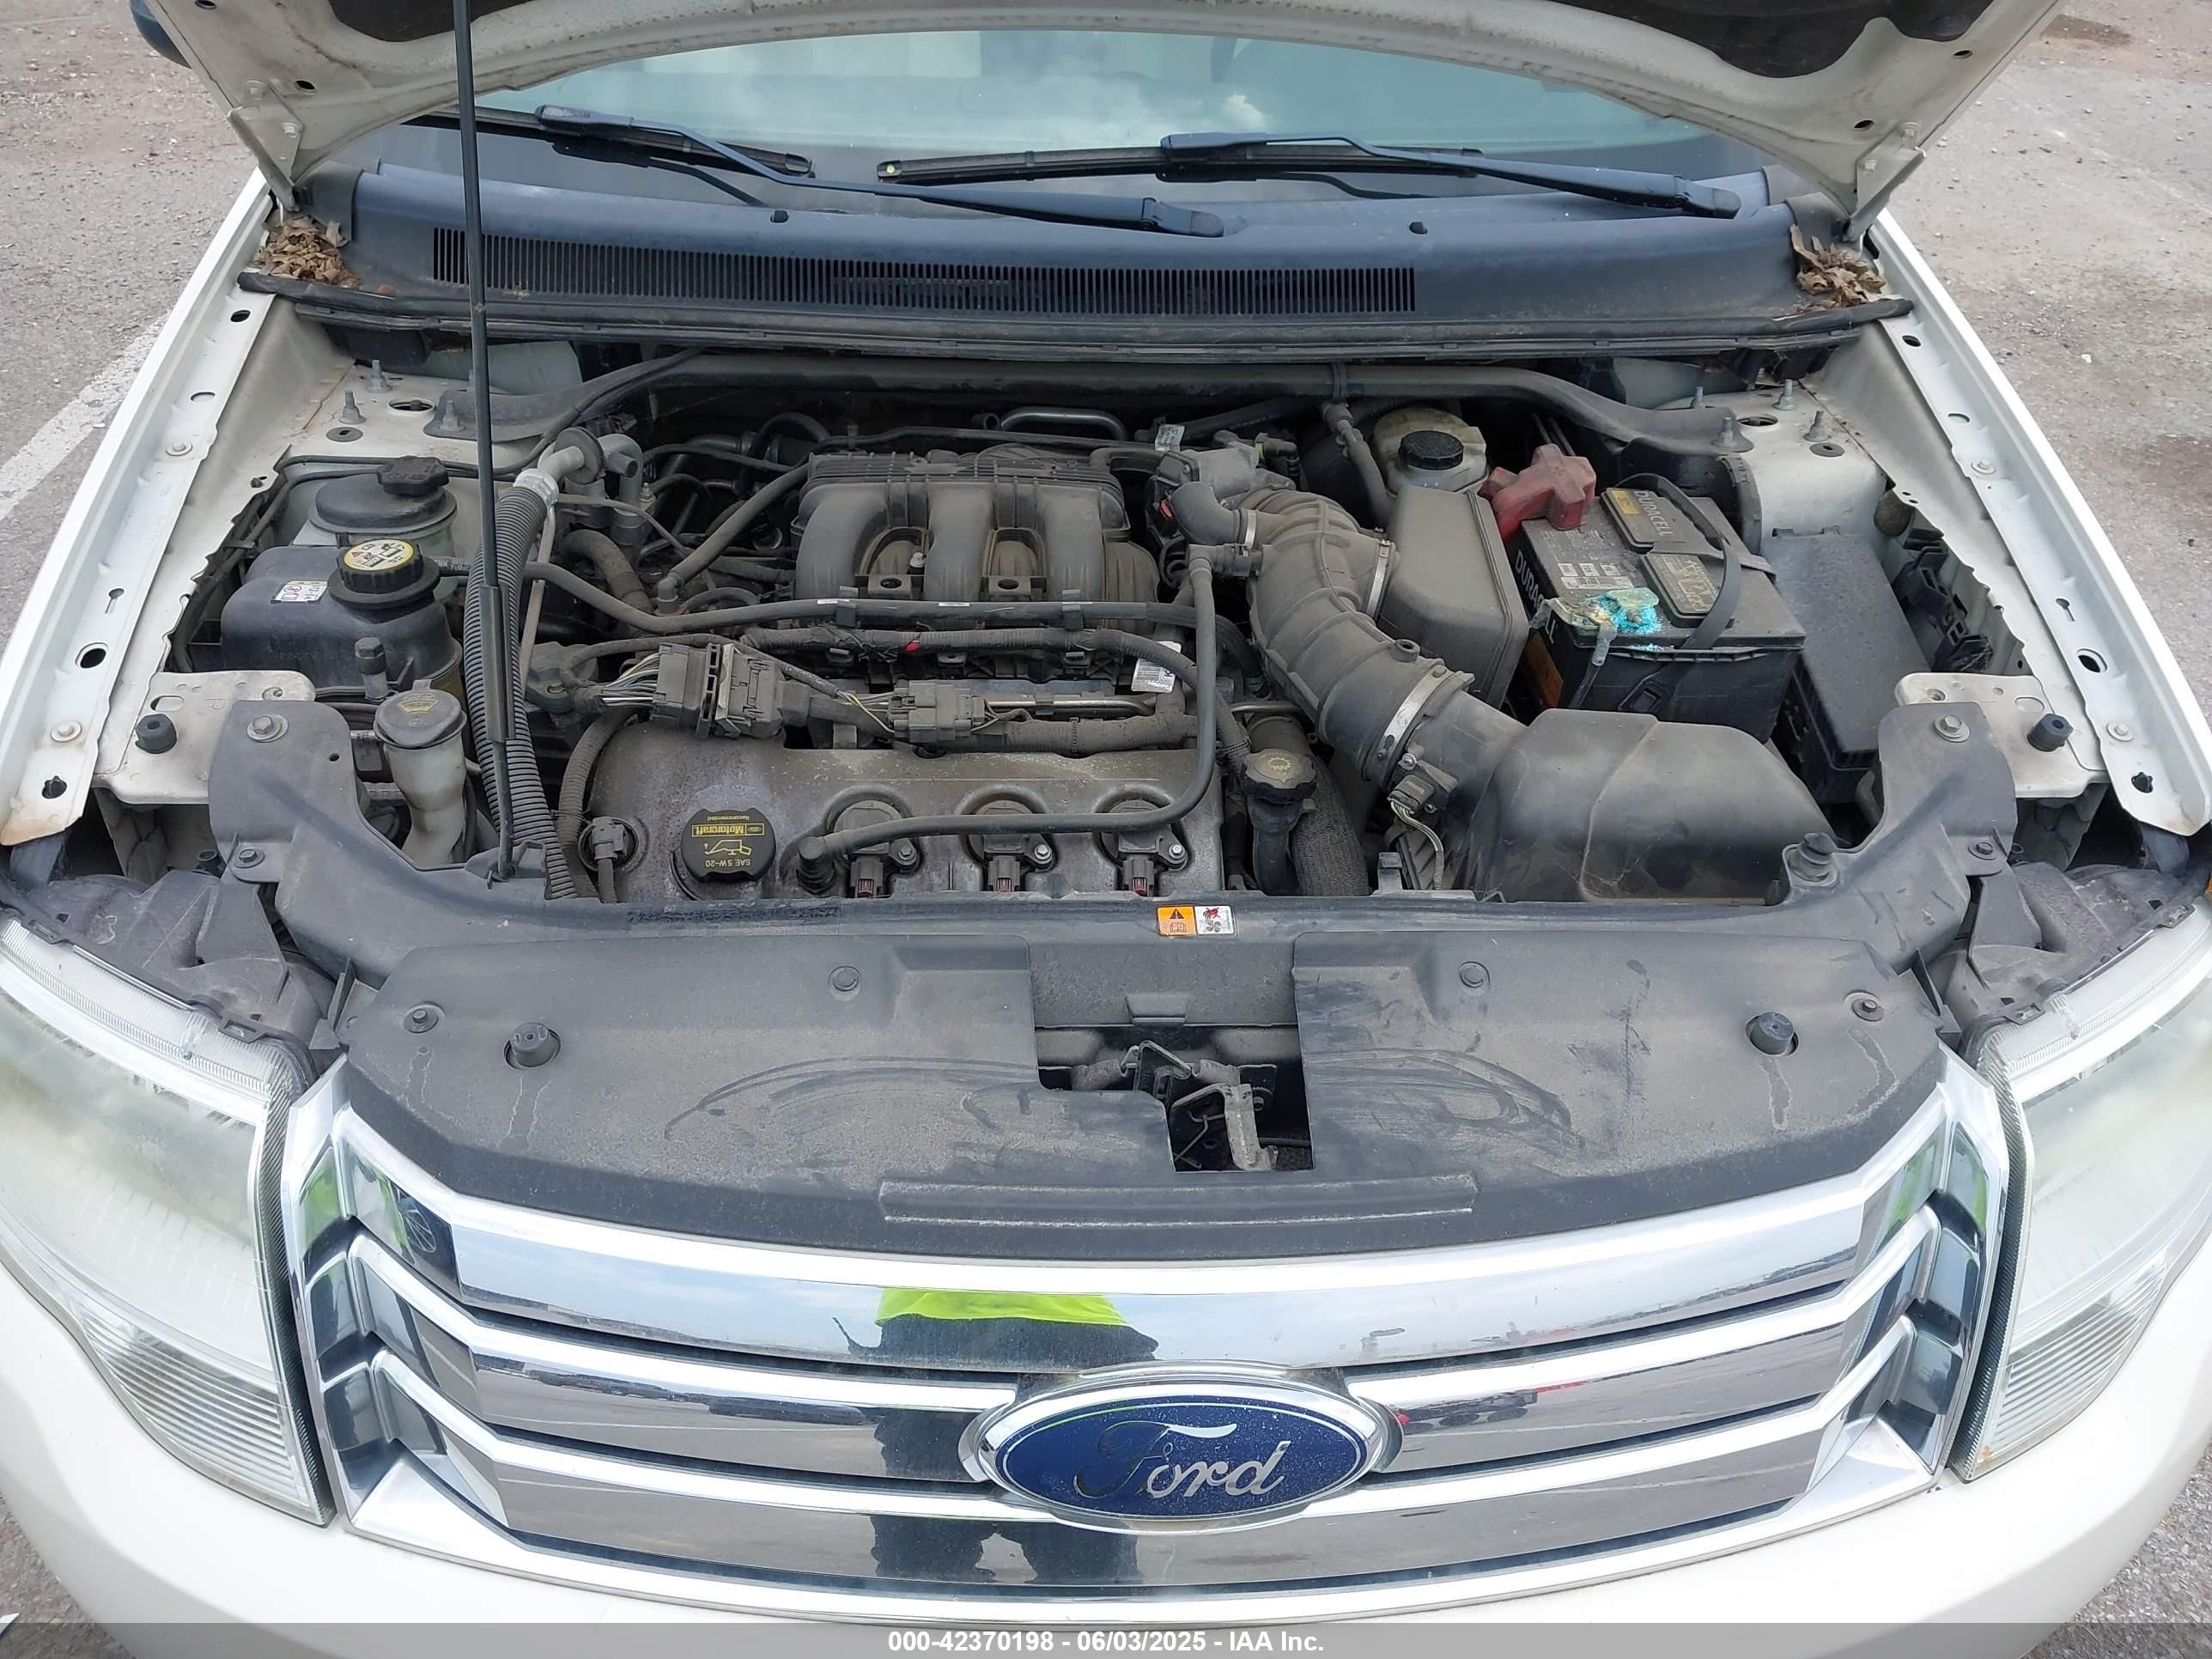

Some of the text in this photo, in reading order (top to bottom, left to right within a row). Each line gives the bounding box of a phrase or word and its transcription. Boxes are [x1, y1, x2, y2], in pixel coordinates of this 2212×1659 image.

[1633, 490, 1674, 537] DURACELL
[694, 825, 744, 836] Motorcraft
[1073, 1419, 1292, 1498] Ford
